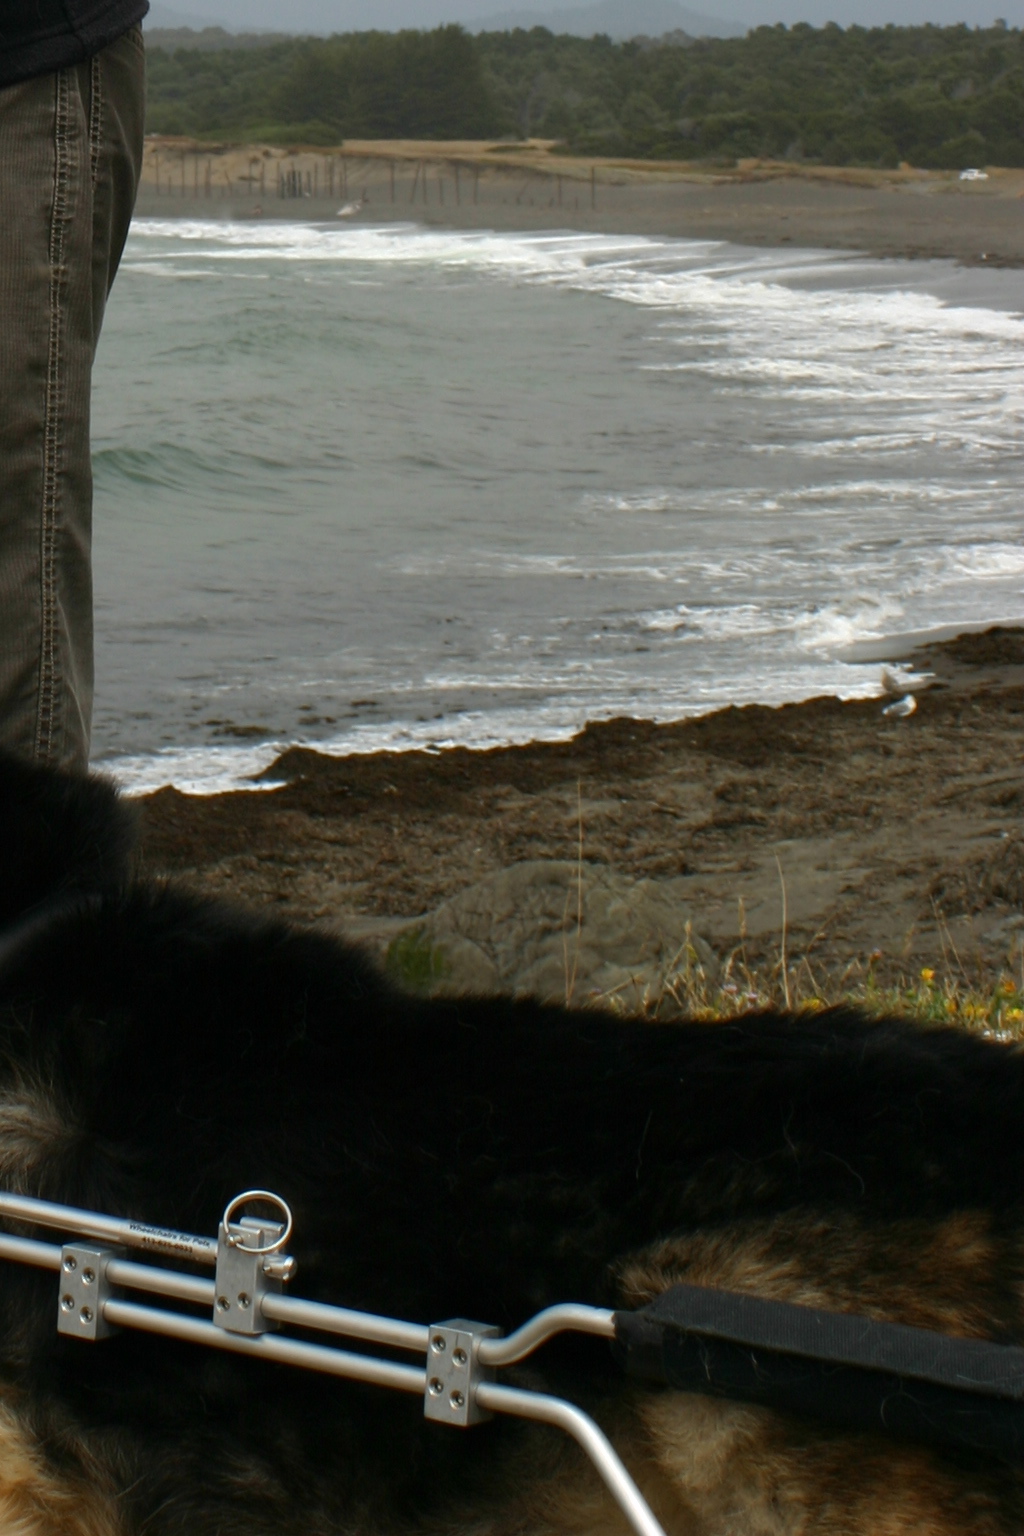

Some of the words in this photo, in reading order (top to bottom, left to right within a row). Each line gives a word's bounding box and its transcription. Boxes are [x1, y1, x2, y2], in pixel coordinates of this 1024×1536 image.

[129, 1224, 177, 1239] Wheelchairs
[179, 1234, 190, 1242] for
[192, 1237, 210, 1247] Pets
